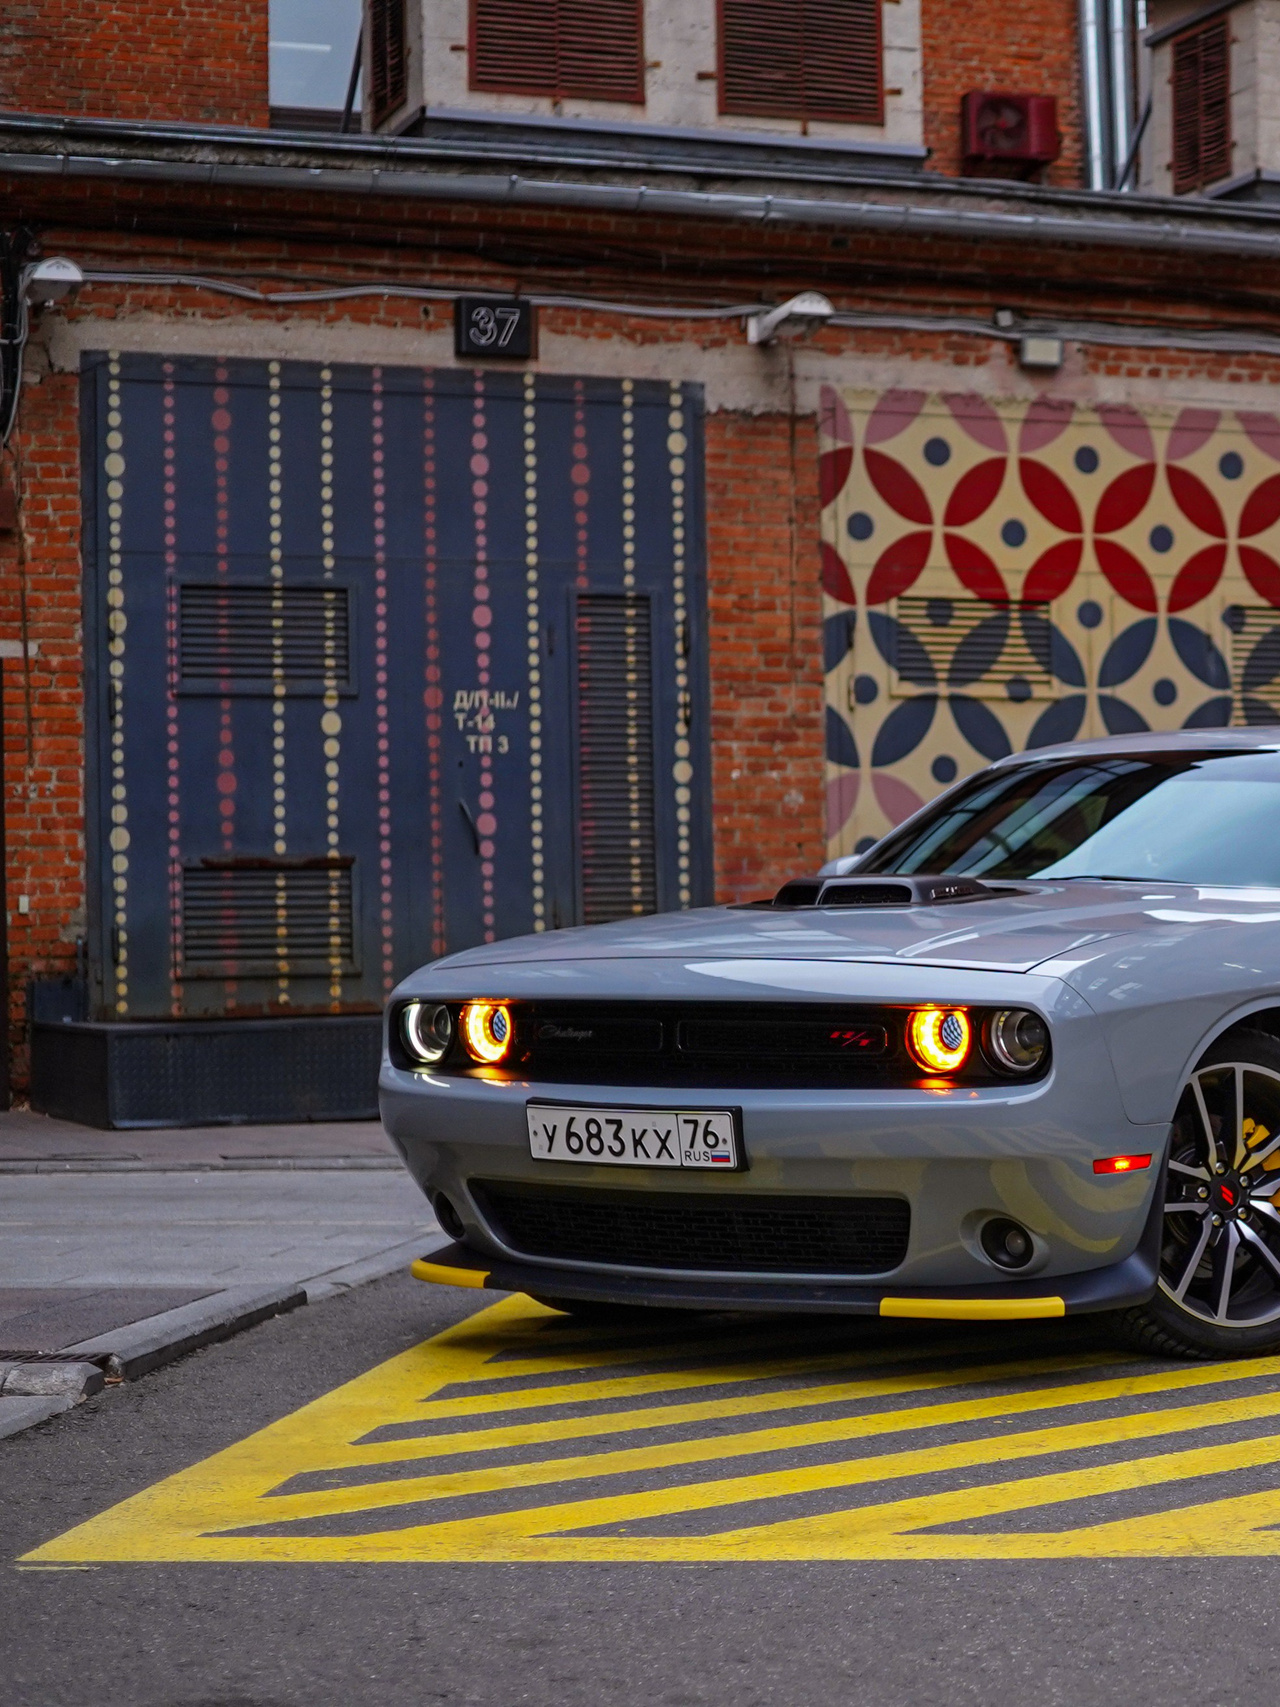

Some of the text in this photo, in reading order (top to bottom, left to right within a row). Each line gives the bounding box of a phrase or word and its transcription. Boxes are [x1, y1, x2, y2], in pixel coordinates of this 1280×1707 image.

[469, 306, 521, 347] 37
[683, 1119, 720, 1150] 76
[684, 1150, 711, 1162] RUS
